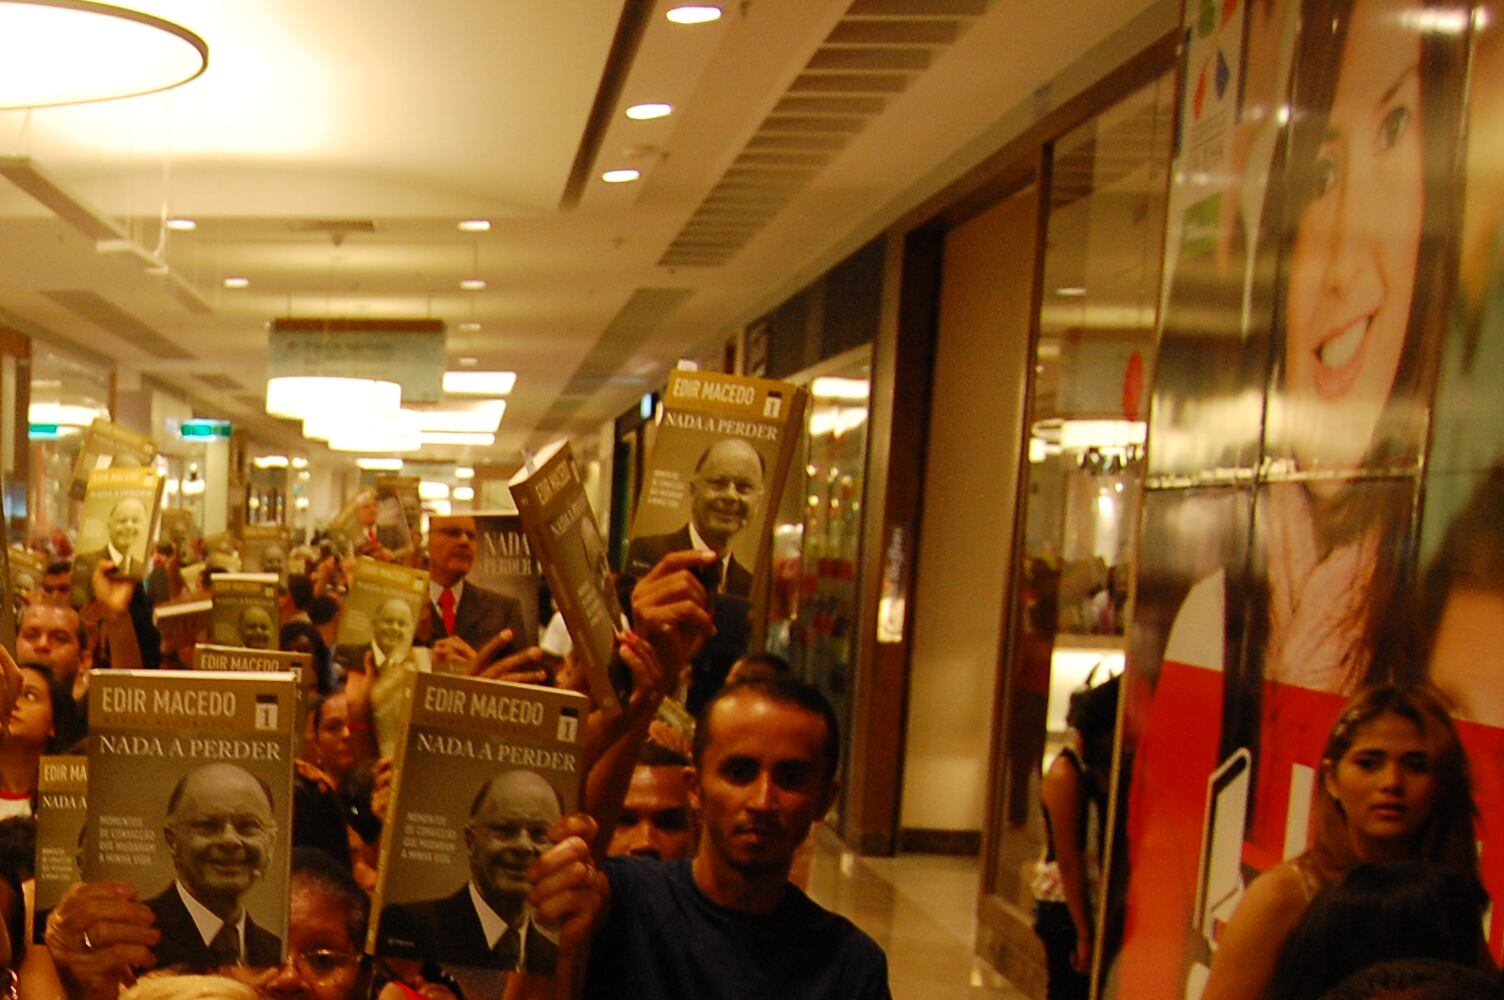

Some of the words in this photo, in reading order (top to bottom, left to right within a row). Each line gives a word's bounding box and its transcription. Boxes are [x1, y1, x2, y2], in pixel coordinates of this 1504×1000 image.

[673, 378, 701, 398] EDIR
[702, 381, 755, 405] MACEDO
[665, 412, 702, 431] NADA
[704, 419, 714, 433] A
[715, 420, 778, 441] PERDER
[484, 531, 531, 556] NADA
[200, 654, 228, 671] EDIR
[230, 656, 279, 672] MACEDO
[102, 686, 146, 714] EDIR
[153, 688, 236, 718] MACEDO
[424, 686, 466, 715] EDIR
[470, 692, 544, 727] MACEDO
[99, 735, 164, 758] NADA
[167, 737, 185, 758] A
[189, 739, 281, 761] PERDER
[417, 732, 475, 759] NADA
[478, 741, 494, 762] A
[498, 744, 577, 773] PERDER
[44, 763, 67, 782] EDIR
[42, 795, 76, 809] NADA
